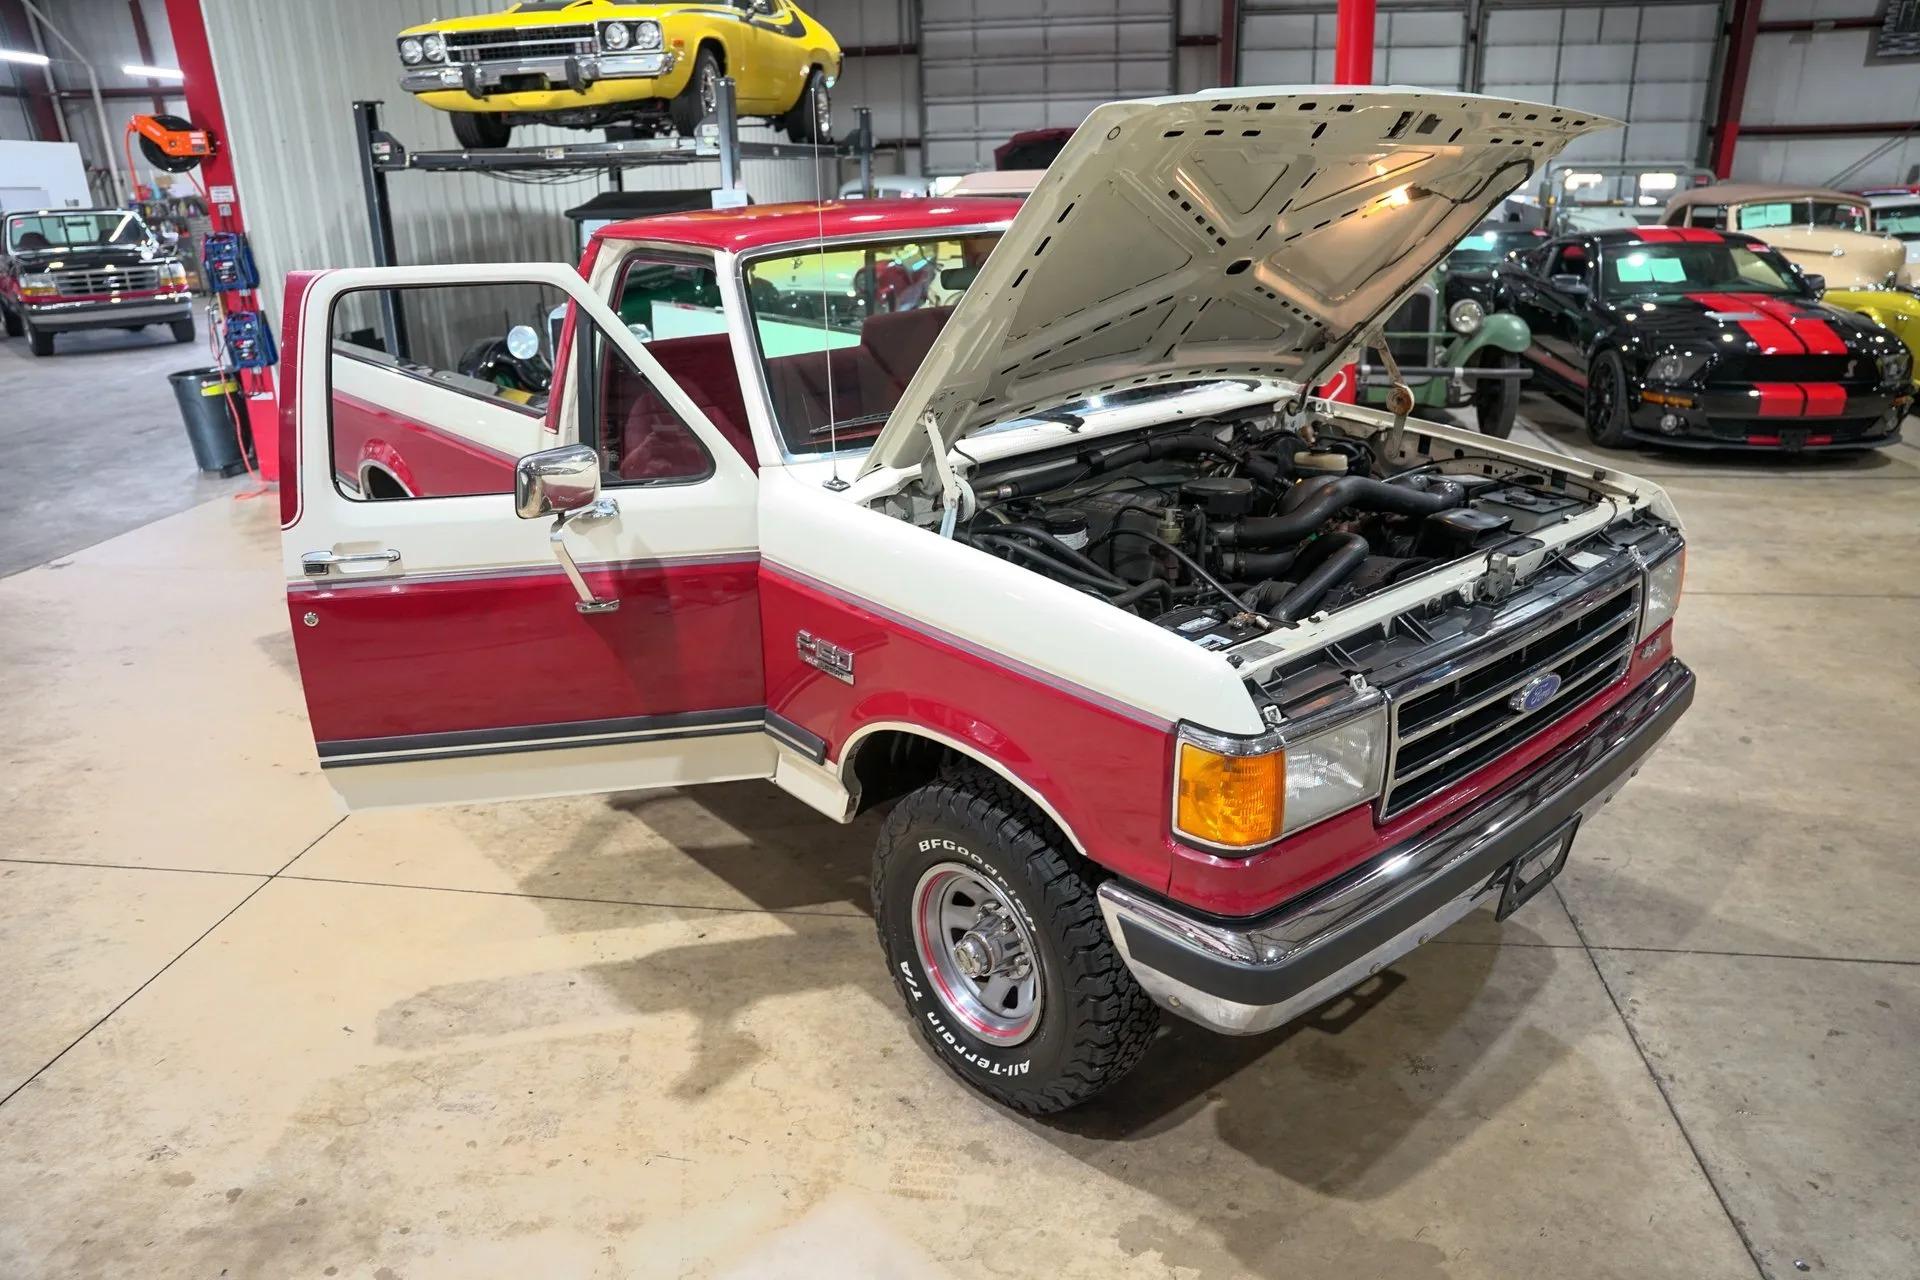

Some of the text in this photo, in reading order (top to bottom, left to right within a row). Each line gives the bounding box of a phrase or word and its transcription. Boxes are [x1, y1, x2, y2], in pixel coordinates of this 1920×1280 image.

[918, 838, 1037, 932] BFGoodrich
[900, 961, 1031, 1077] All-Terrain T/A
